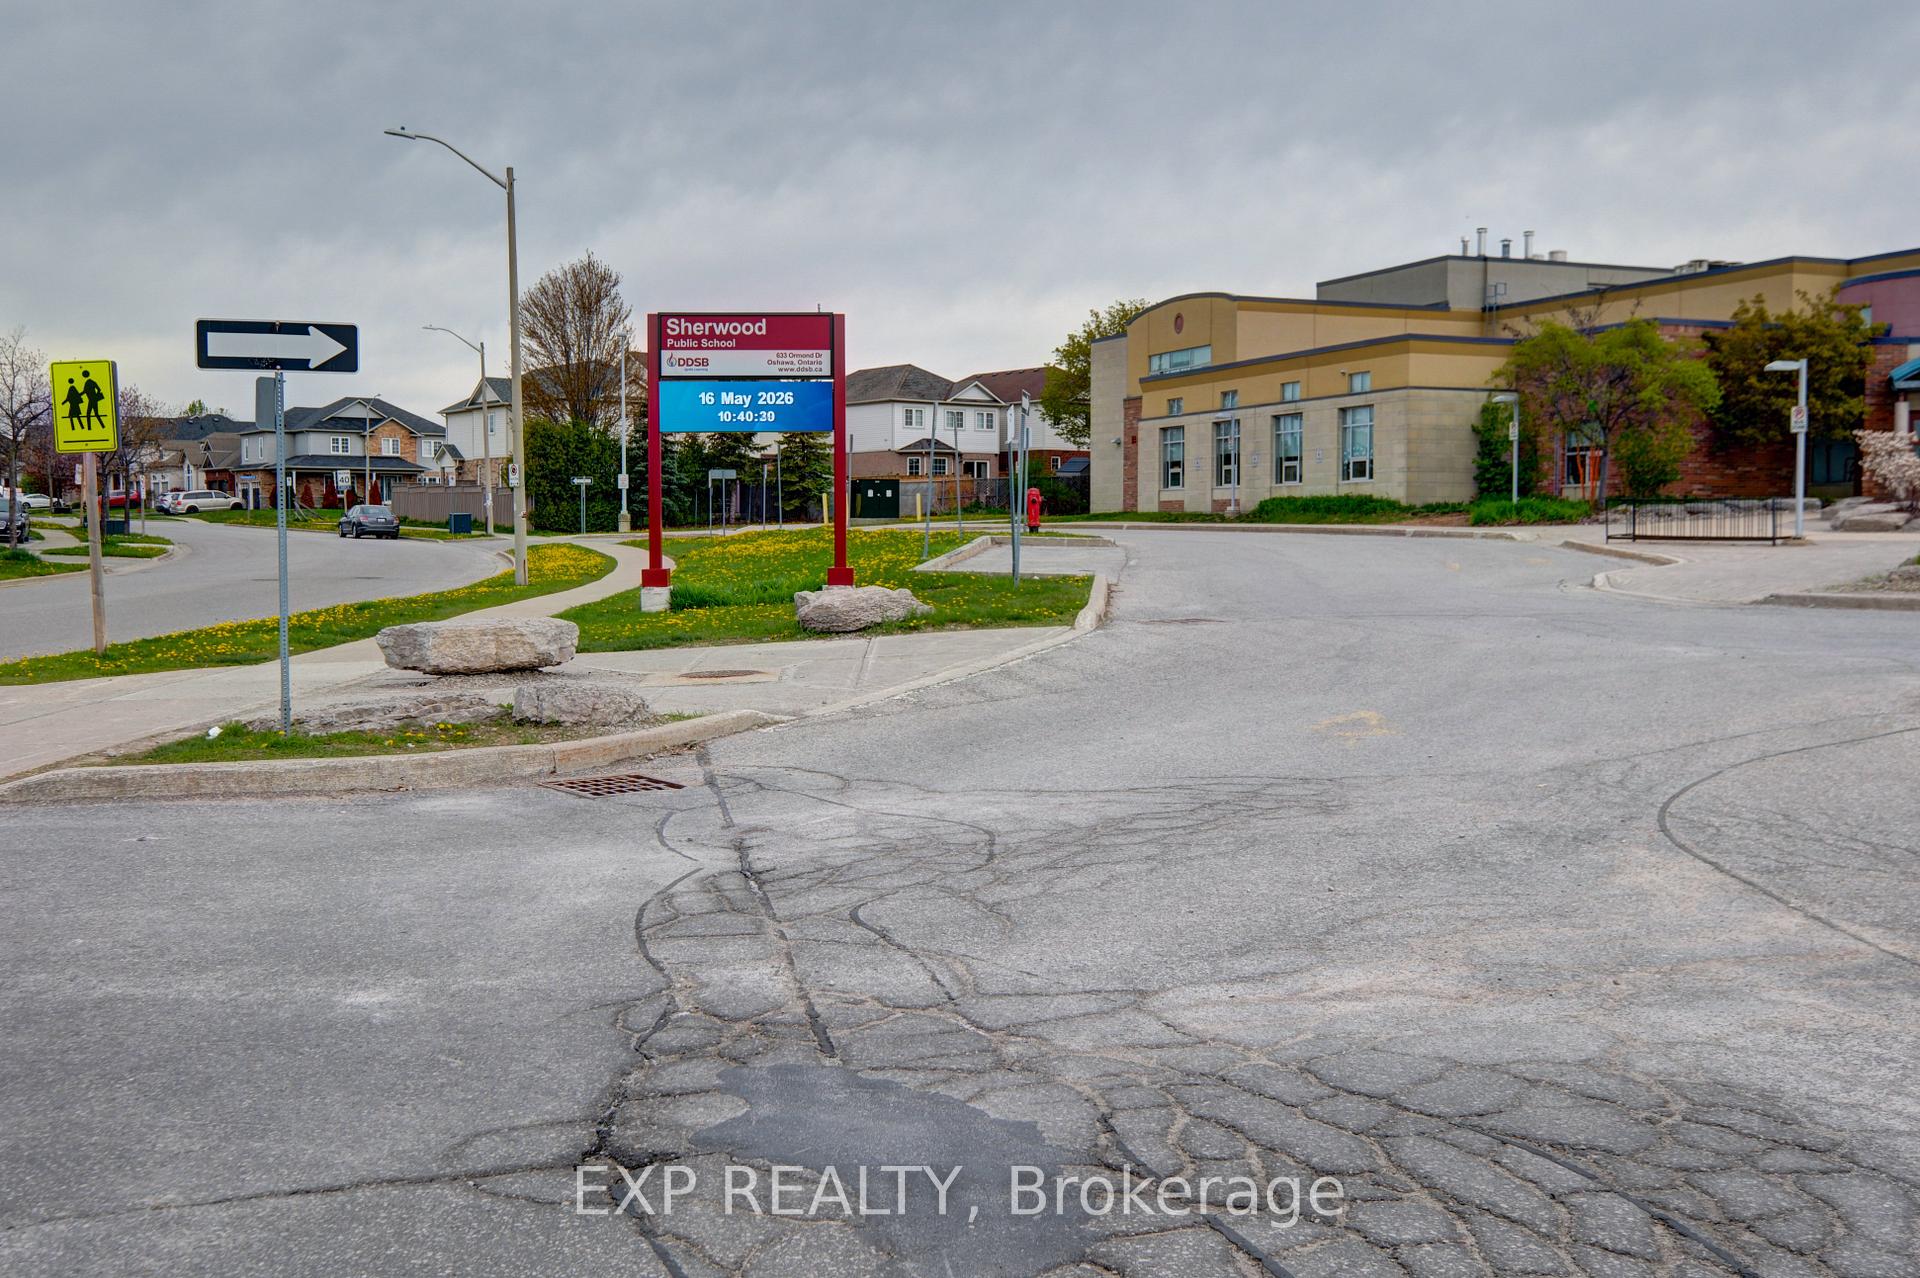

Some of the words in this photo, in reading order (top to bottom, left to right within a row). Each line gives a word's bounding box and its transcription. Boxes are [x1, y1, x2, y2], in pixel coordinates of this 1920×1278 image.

[666, 318, 767, 336] Sherwood
[667, 338, 699, 348] Public
[701, 338, 736, 348] School
[677, 357, 710, 367] DDSB
[699, 392, 715, 405] 16
[721, 392, 752, 408] May
[758, 392, 794, 405] 2026
[340, 476, 350, 484] 40
